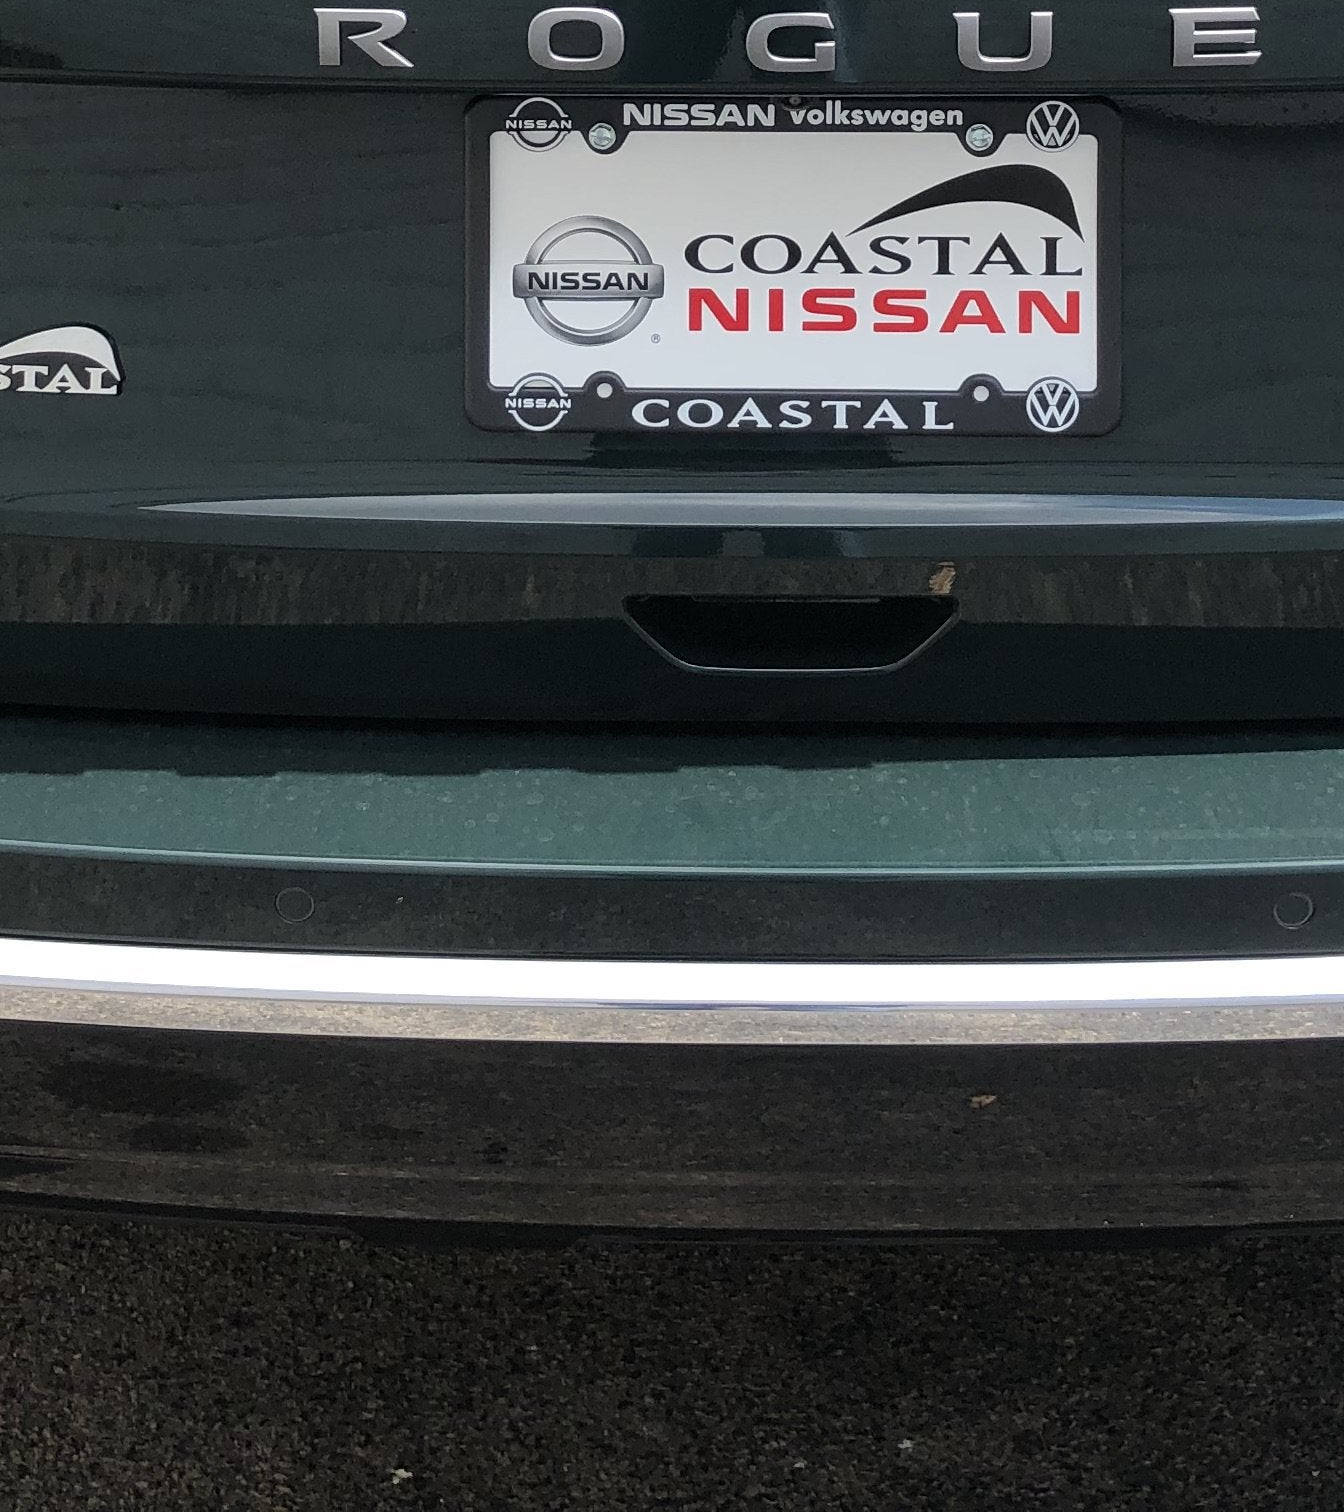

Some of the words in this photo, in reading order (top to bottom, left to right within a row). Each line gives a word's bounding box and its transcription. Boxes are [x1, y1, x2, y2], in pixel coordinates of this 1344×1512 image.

[312, 5, 1262, 73] ROGUE
[505, 119, 573, 130] NISSAN
[622, 102, 776, 127] NISSAN
[789, 99, 964, 132] volkswagen
[683, 230, 1084, 277] COASTAL
[527, 271, 649, 291] NISSAN
[688, 287, 1081, 335] NISSAN
[504, 397, 572, 409] NISSAN
[631, 396, 955, 430] COASTAL
